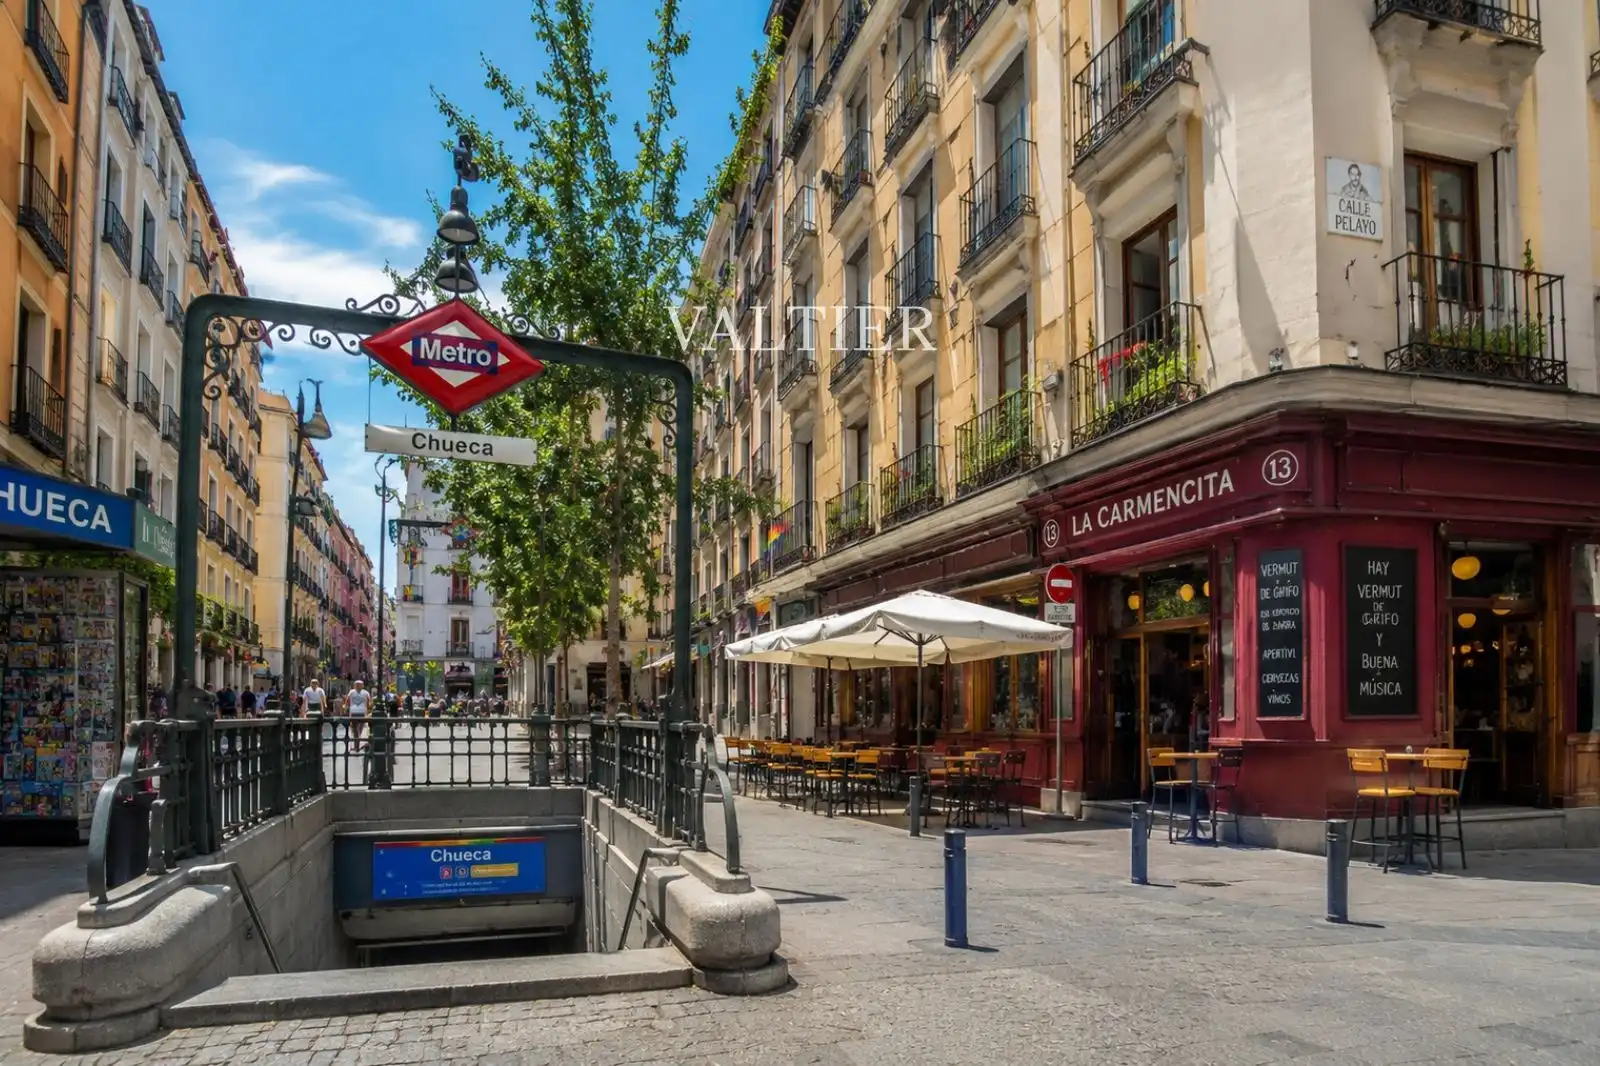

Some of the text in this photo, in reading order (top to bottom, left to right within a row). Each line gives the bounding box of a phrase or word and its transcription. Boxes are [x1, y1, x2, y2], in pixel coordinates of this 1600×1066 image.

[1338, 198, 1371, 218] CALLE
[1335, 214, 1376, 235] PELAYO
[419, 337, 492, 367] Metro
[411, 432, 494, 456] Chueca
[1269, 457, 1292, 481] 13
[1072, 468, 1235, 537] LA CARMENCITA
[1046, 524, 1057, 542] 13
[1367, 560, 1390, 576] HAY
[1357, 584, 1403, 599] VERMUT
[1373, 602, 1384, 612] DE
[1376, 632, 1384, 647] Y
[1359, 678, 1403, 696] MÚSICA
[430, 848, 492, 863] Chueca
